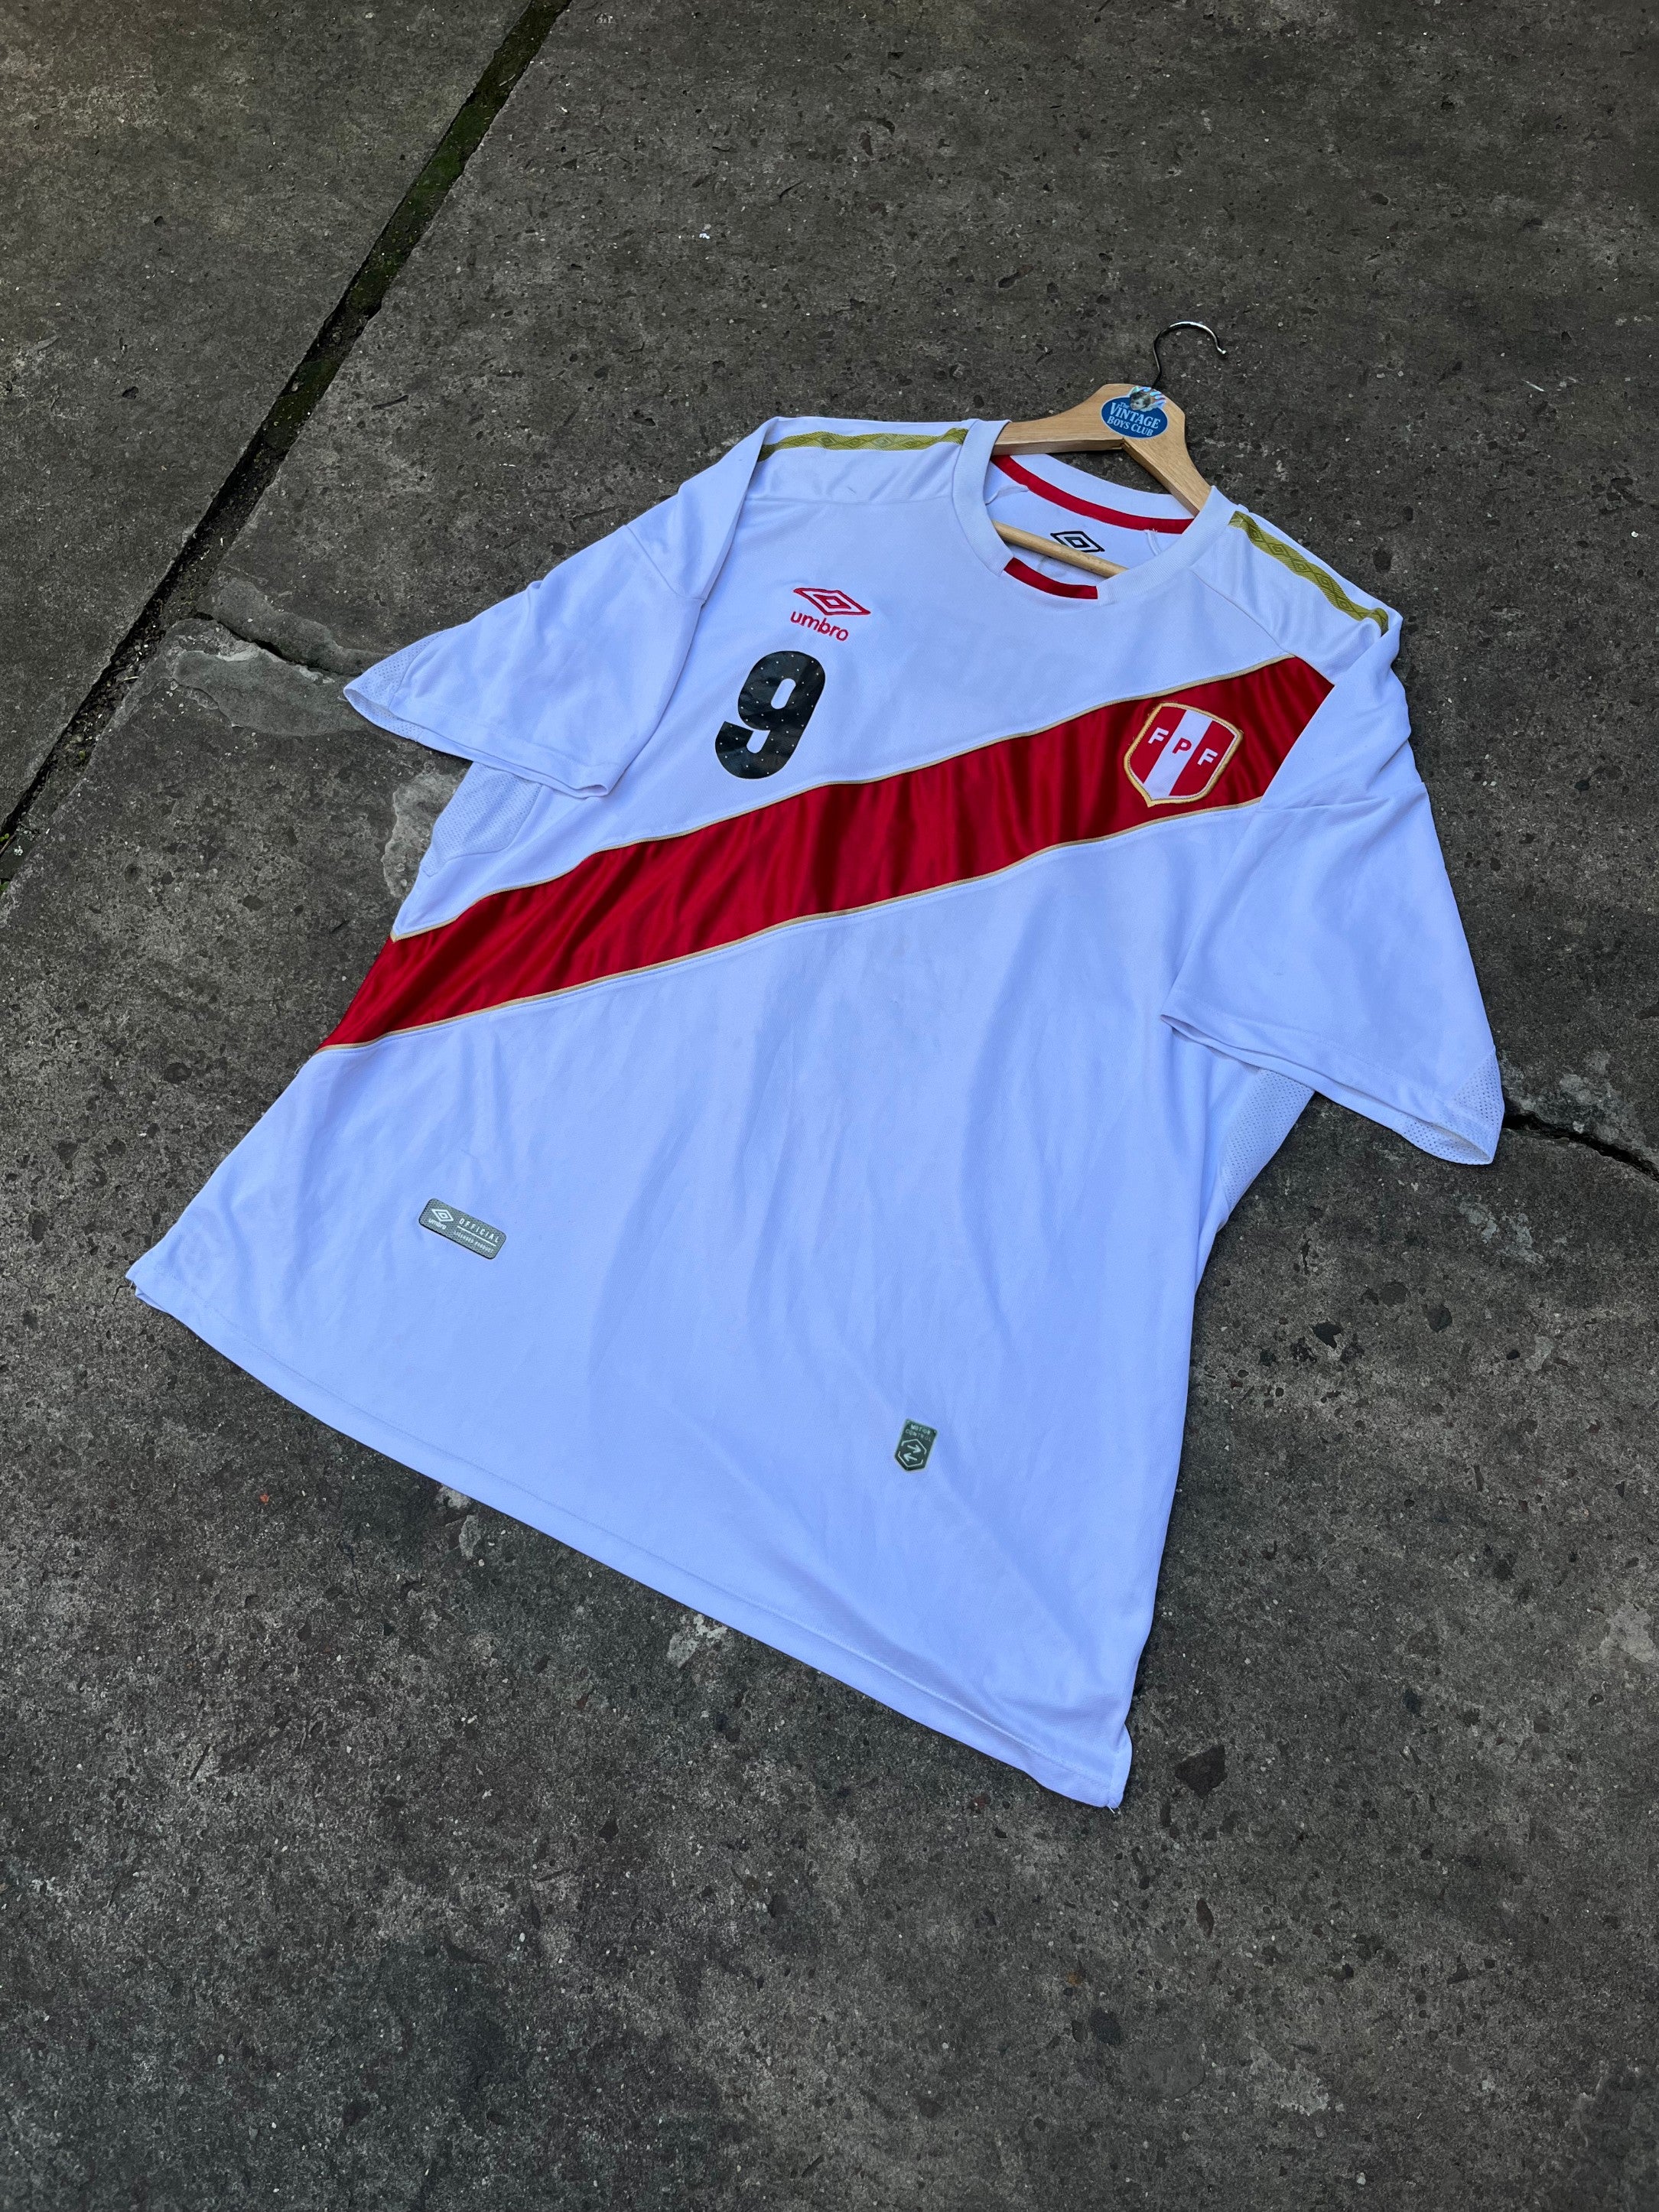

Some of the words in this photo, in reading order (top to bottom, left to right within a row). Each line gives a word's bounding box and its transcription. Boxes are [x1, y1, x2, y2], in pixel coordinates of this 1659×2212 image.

[1106, 415, 1131, 430] BOYS
[1130, 423, 1154, 437] CLUB
[1109, 402, 1161, 429] VINTAGE
[790, 610, 849, 642] umbro
[714, 650, 826, 779] 9
[428, 1218, 447, 1230] umbro
[459, 1218, 499, 1243] OFFICIAL
